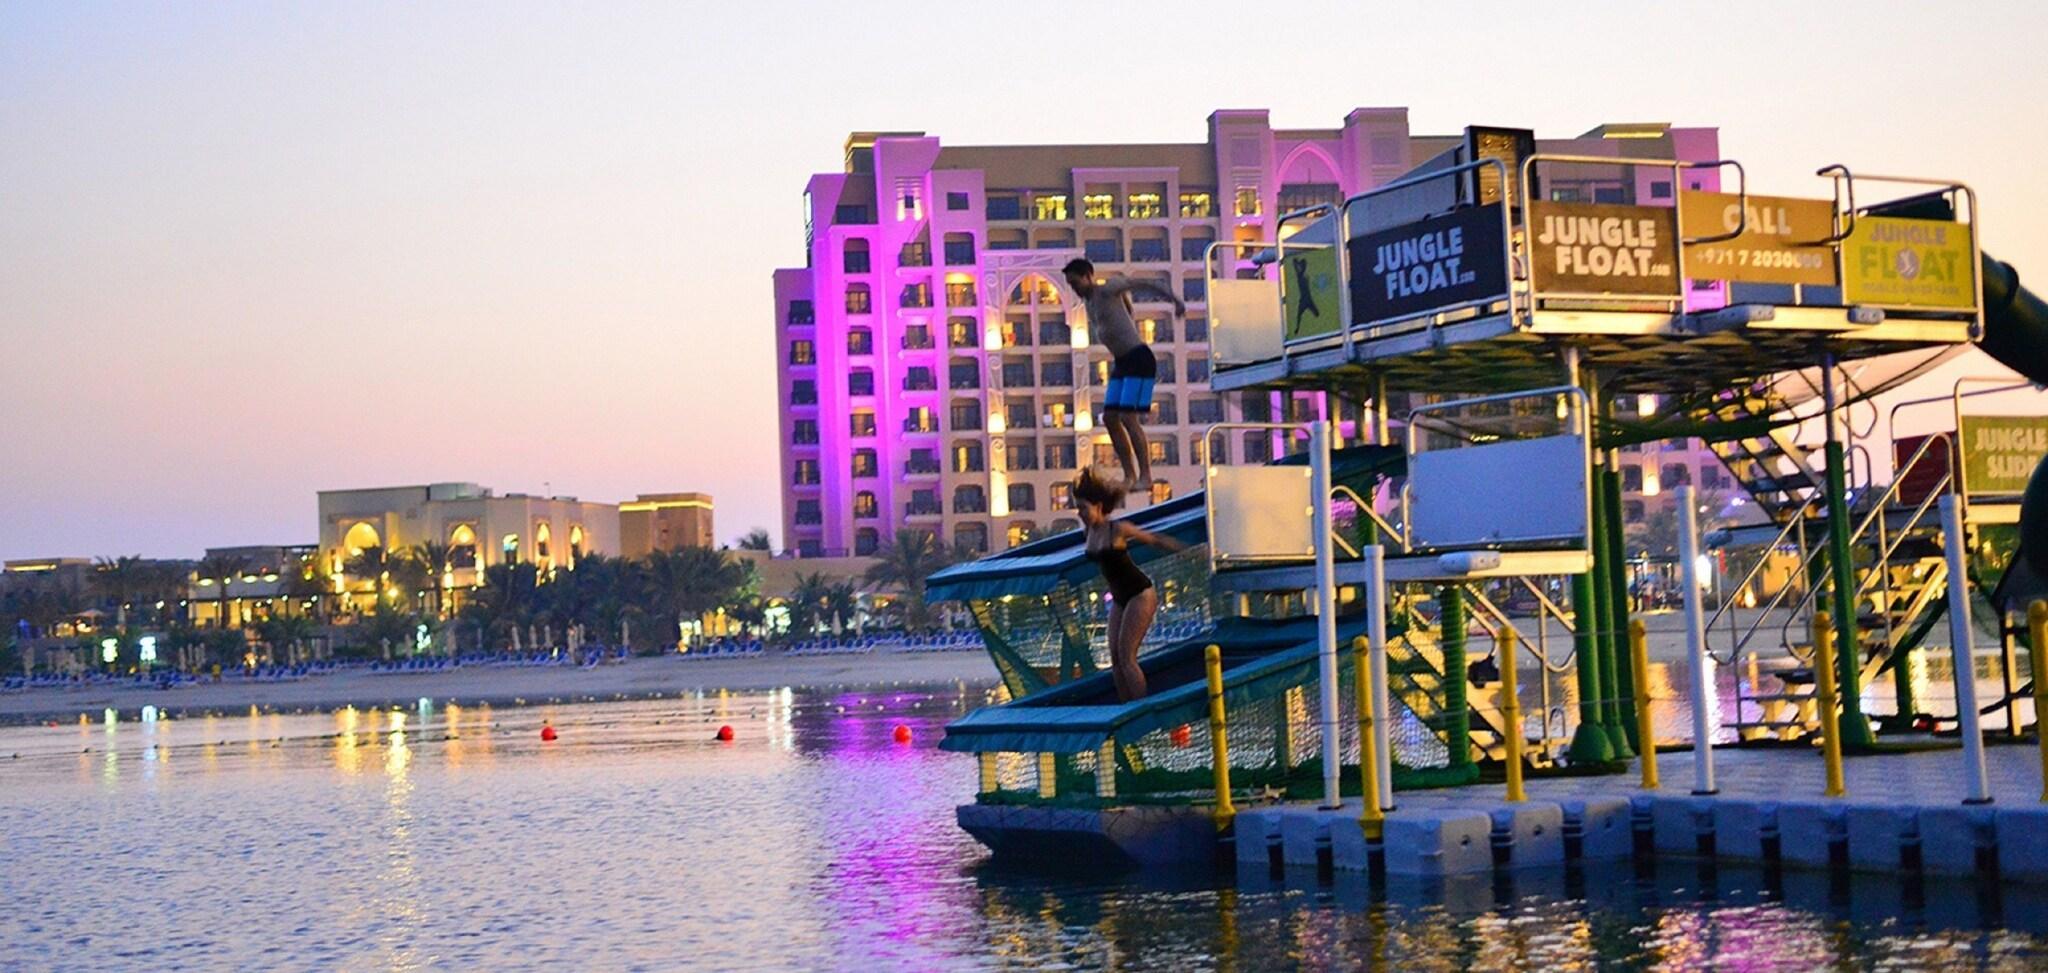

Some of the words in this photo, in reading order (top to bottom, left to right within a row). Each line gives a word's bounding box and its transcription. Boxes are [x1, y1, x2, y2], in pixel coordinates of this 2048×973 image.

[1538, 215, 1657, 248] JUNGLE
[1723, 204, 1792, 235] CALL
[1870, 222, 1947, 246] JUNGLE
[1373, 226, 1464, 275] JUNGLE
[1737, 249, 1750, 267] 7
[1974, 427, 2048, 452] JUNGLE
